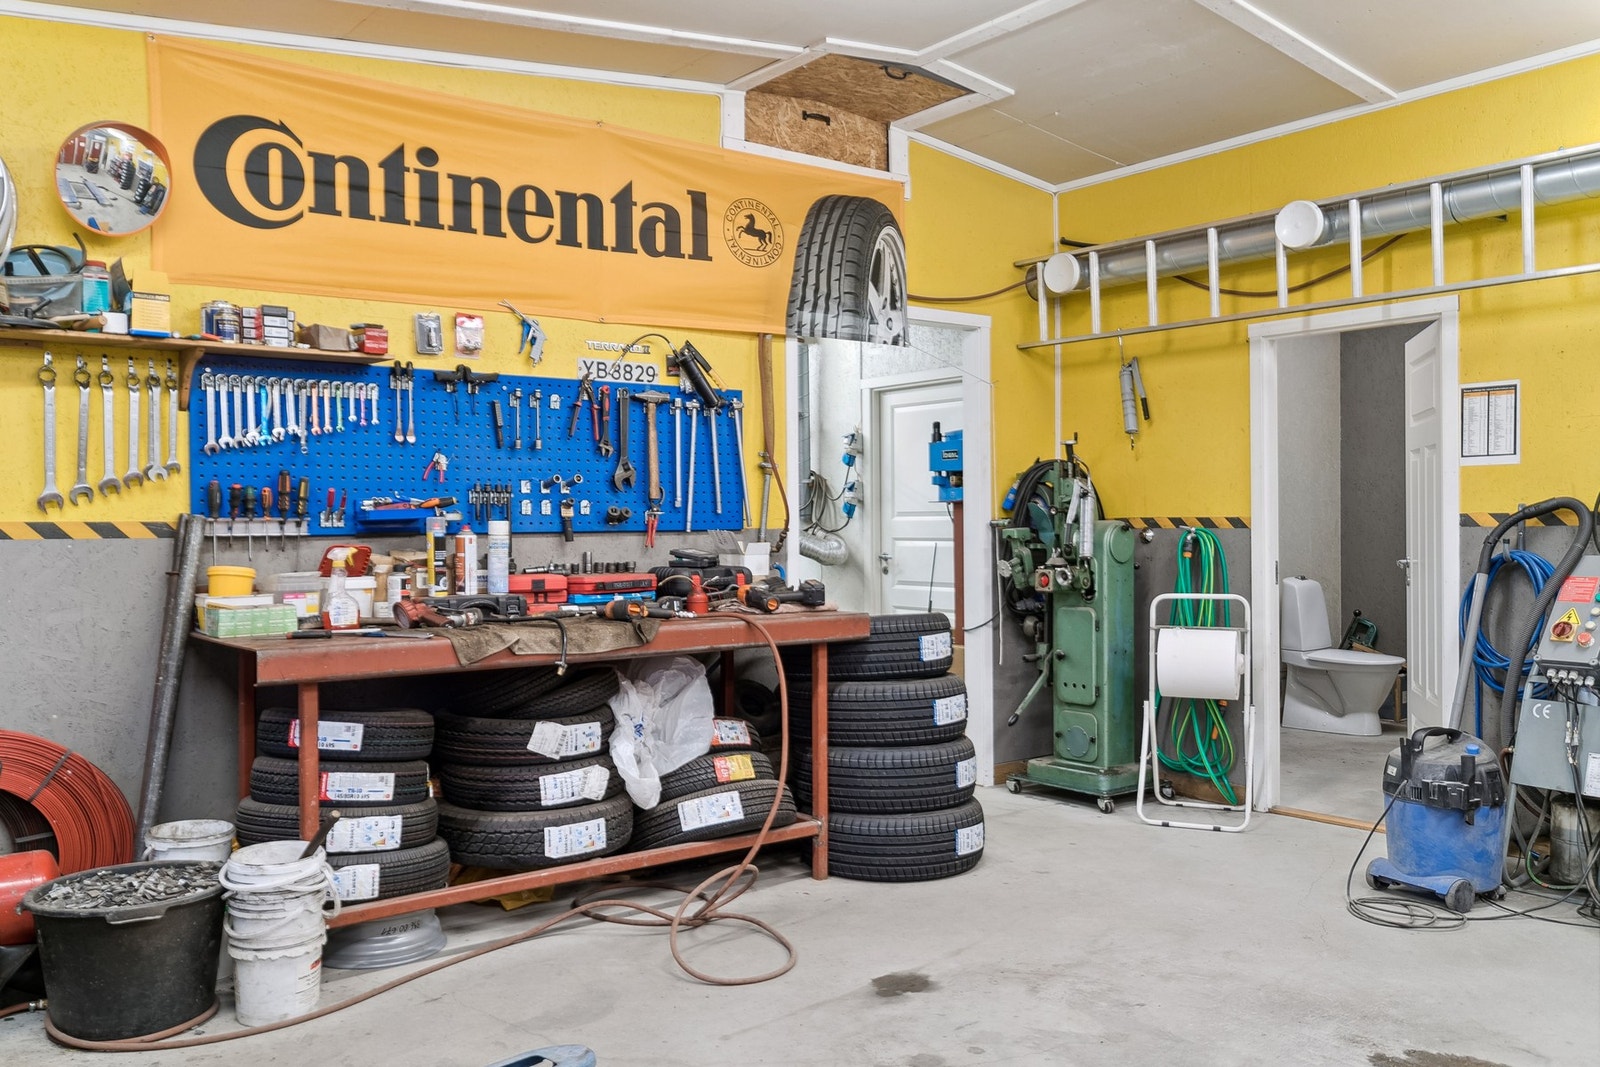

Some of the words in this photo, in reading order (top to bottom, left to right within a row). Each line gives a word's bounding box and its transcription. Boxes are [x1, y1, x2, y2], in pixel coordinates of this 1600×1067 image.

[193, 114, 712, 262] Continental
[725, 200, 780, 230] CONTINENTAL
[727, 236, 782, 266] CONTINENTAL
[1533, 703, 1552, 719] CE
